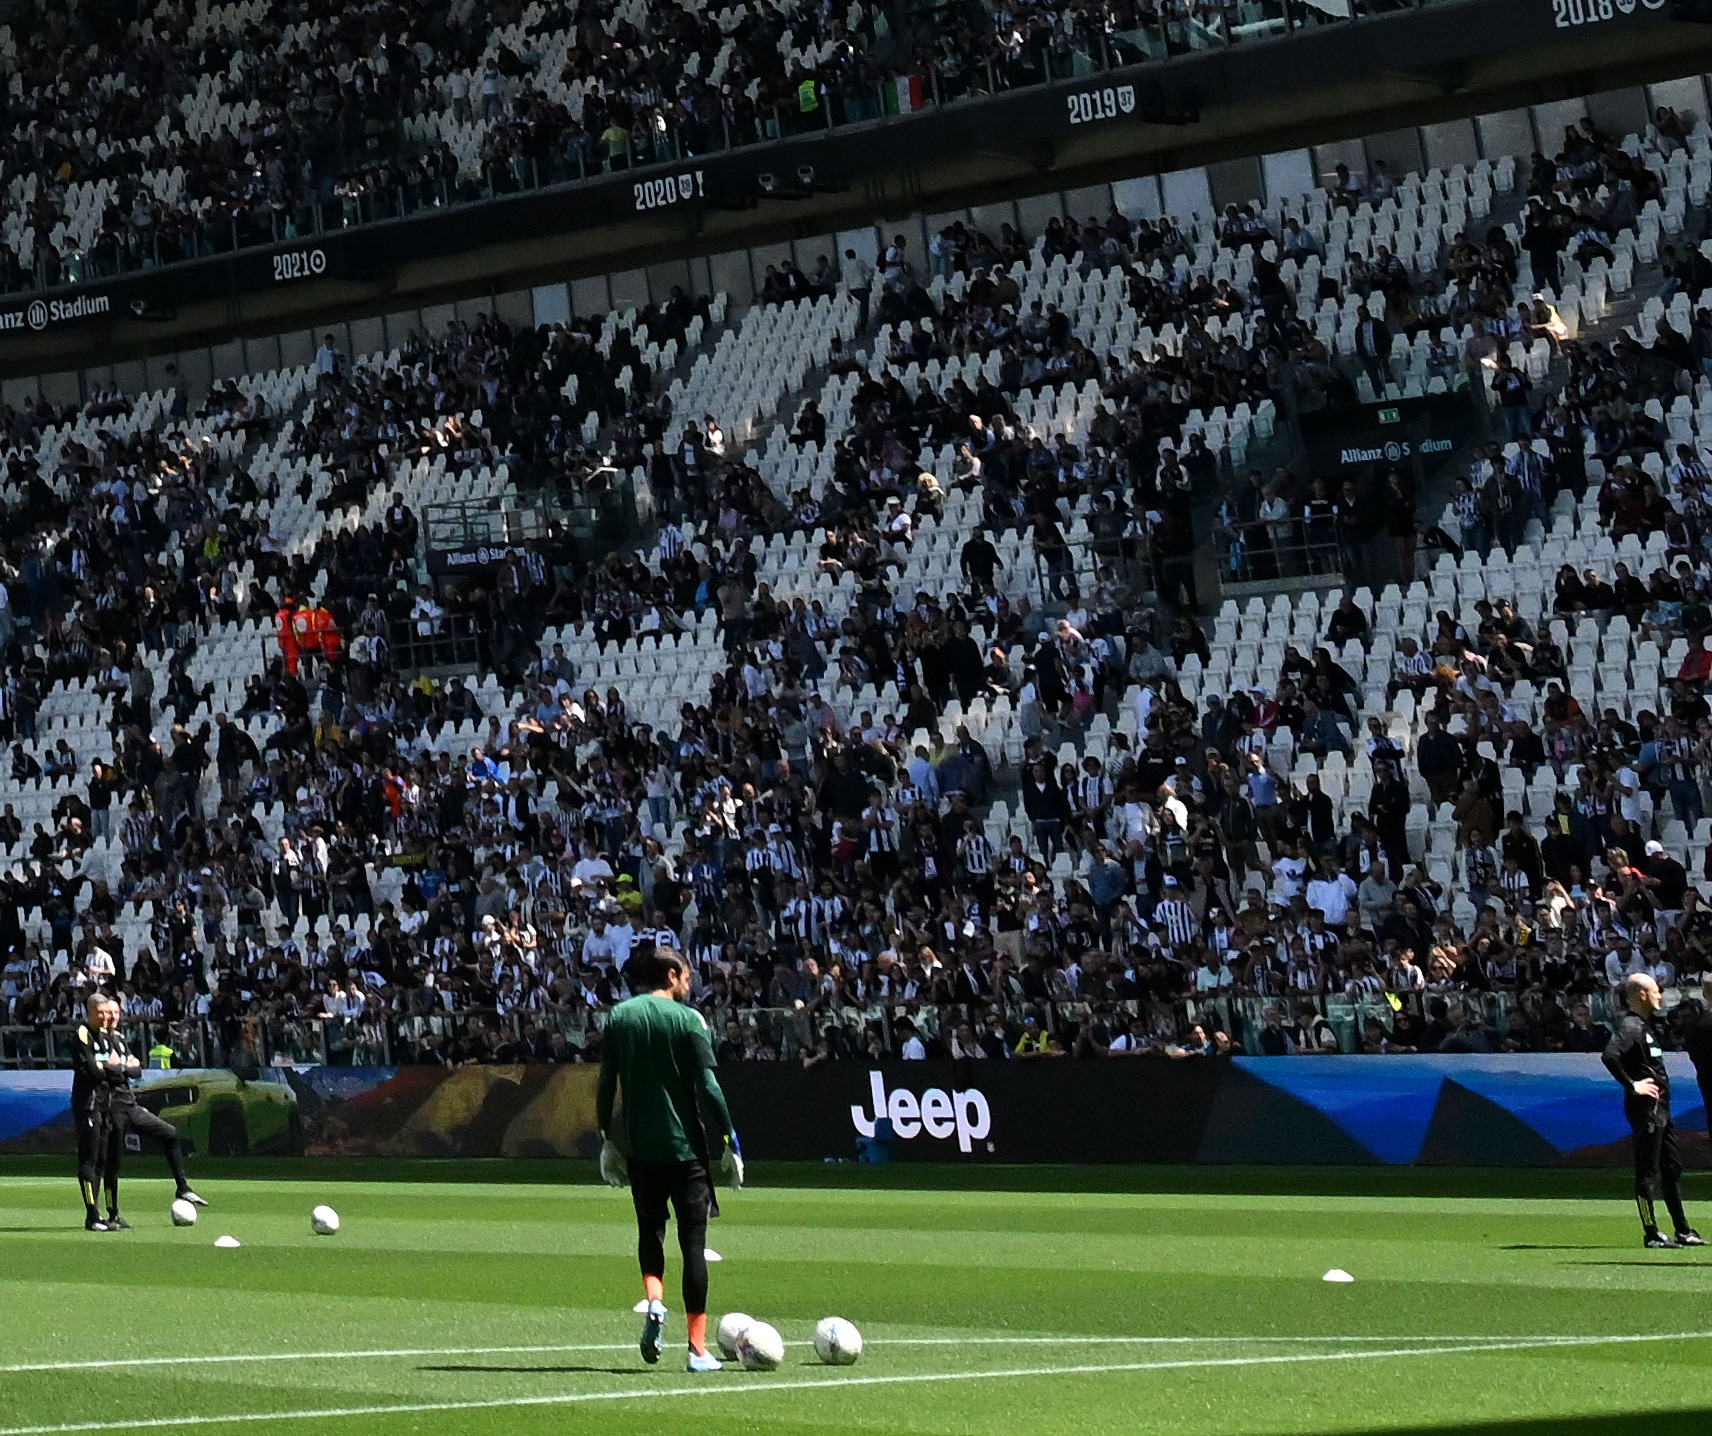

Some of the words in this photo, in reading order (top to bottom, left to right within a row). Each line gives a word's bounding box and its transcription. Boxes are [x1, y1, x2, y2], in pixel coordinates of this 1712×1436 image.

[1067, 88, 1116, 125] 2019
[633, 176, 677, 211] 2020
[273, 250, 310, 281] 2021
[50, 295, 110, 322] Stadium
[1340, 448, 1383, 464] Allianz
[1402, 439, 1452, 456] Sdium
[850, 1070, 992, 1153] Jeep
